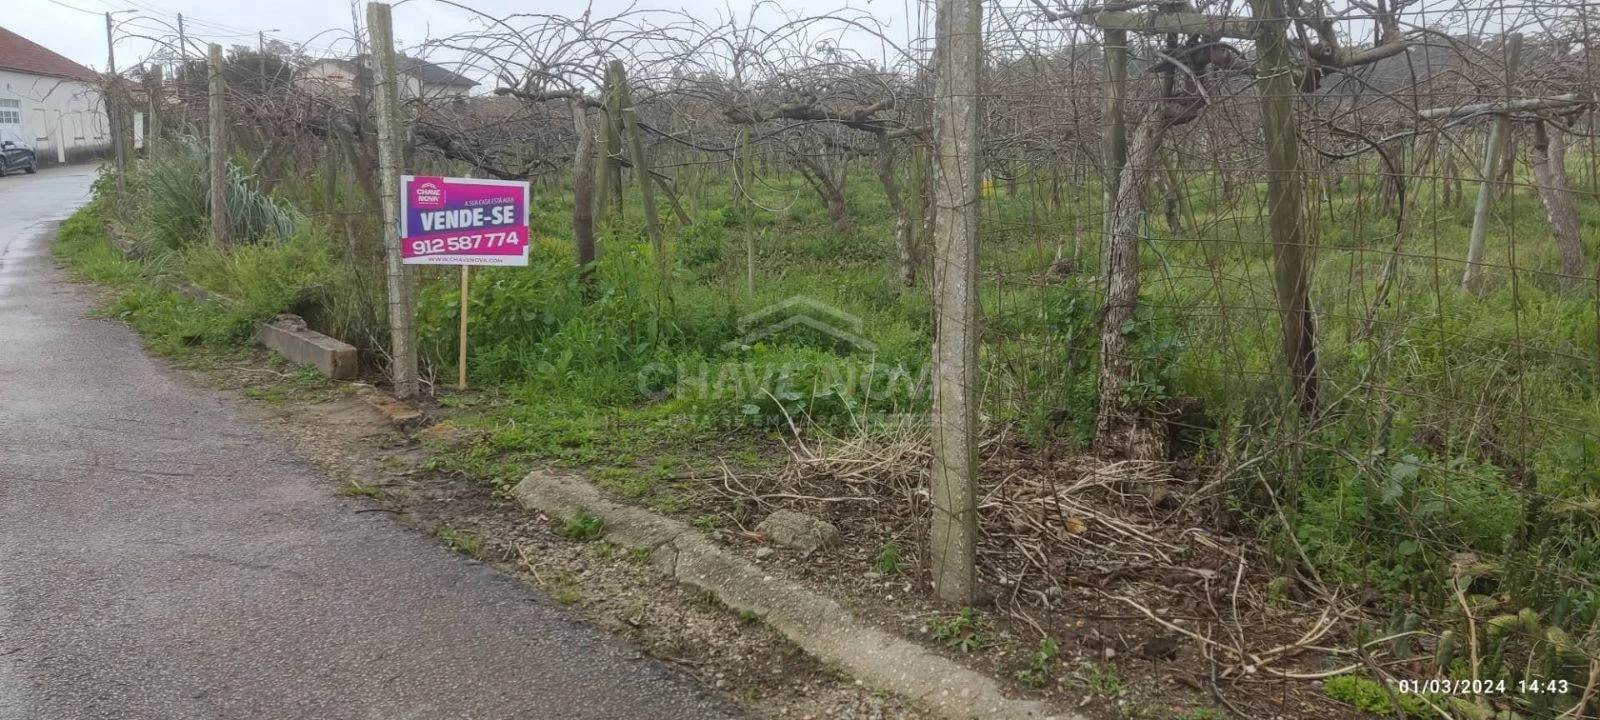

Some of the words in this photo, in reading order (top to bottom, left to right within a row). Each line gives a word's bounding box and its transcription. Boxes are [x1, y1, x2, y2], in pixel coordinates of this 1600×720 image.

[416, 188, 441, 196] CHAVE
[420, 205, 515, 231] VENDE-SE
[412, 239, 445, 255] 912
[447, 235, 482, 251] 587
[484, 231, 519, 247] 774
